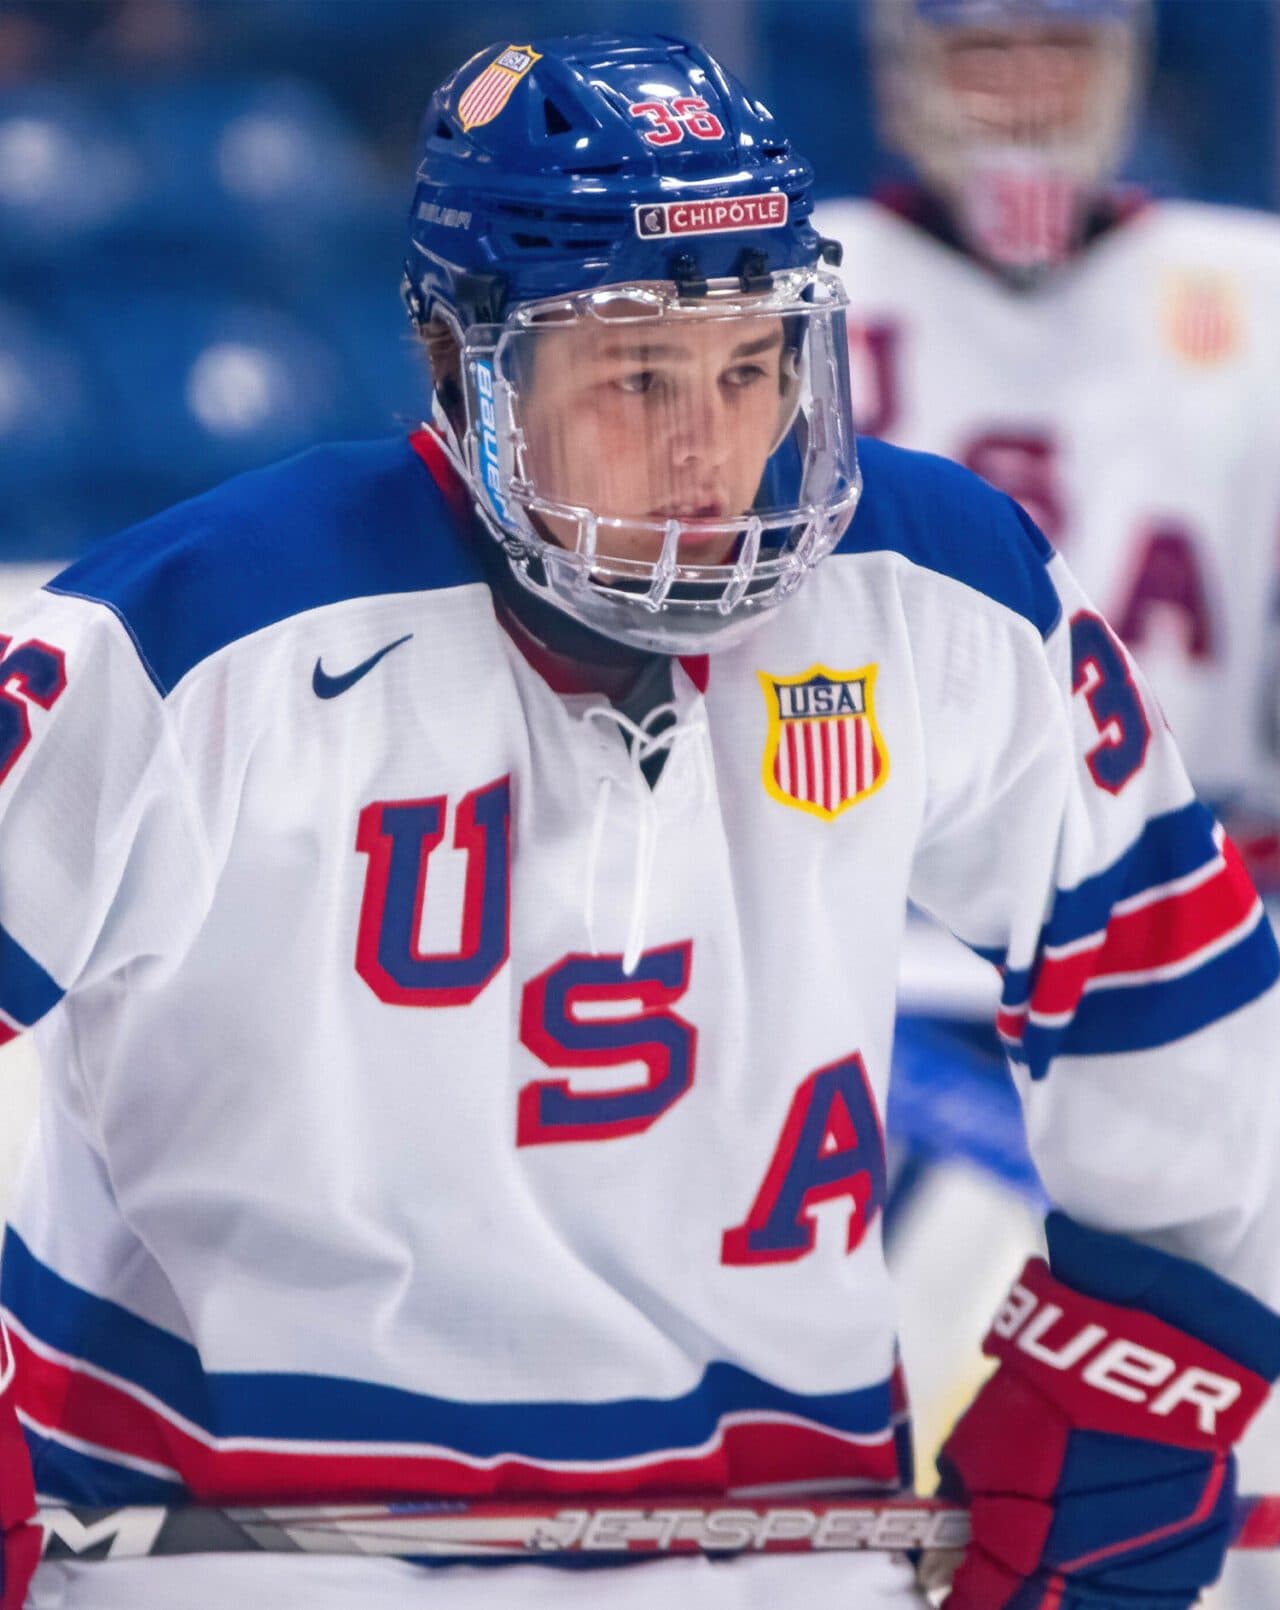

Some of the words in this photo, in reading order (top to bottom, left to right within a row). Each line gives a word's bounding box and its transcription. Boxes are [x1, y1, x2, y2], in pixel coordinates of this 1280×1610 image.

[629, 98, 725, 147] 36
[674, 200, 780, 229] CHIPOTLE
[789, 683, 857, 714] USA
